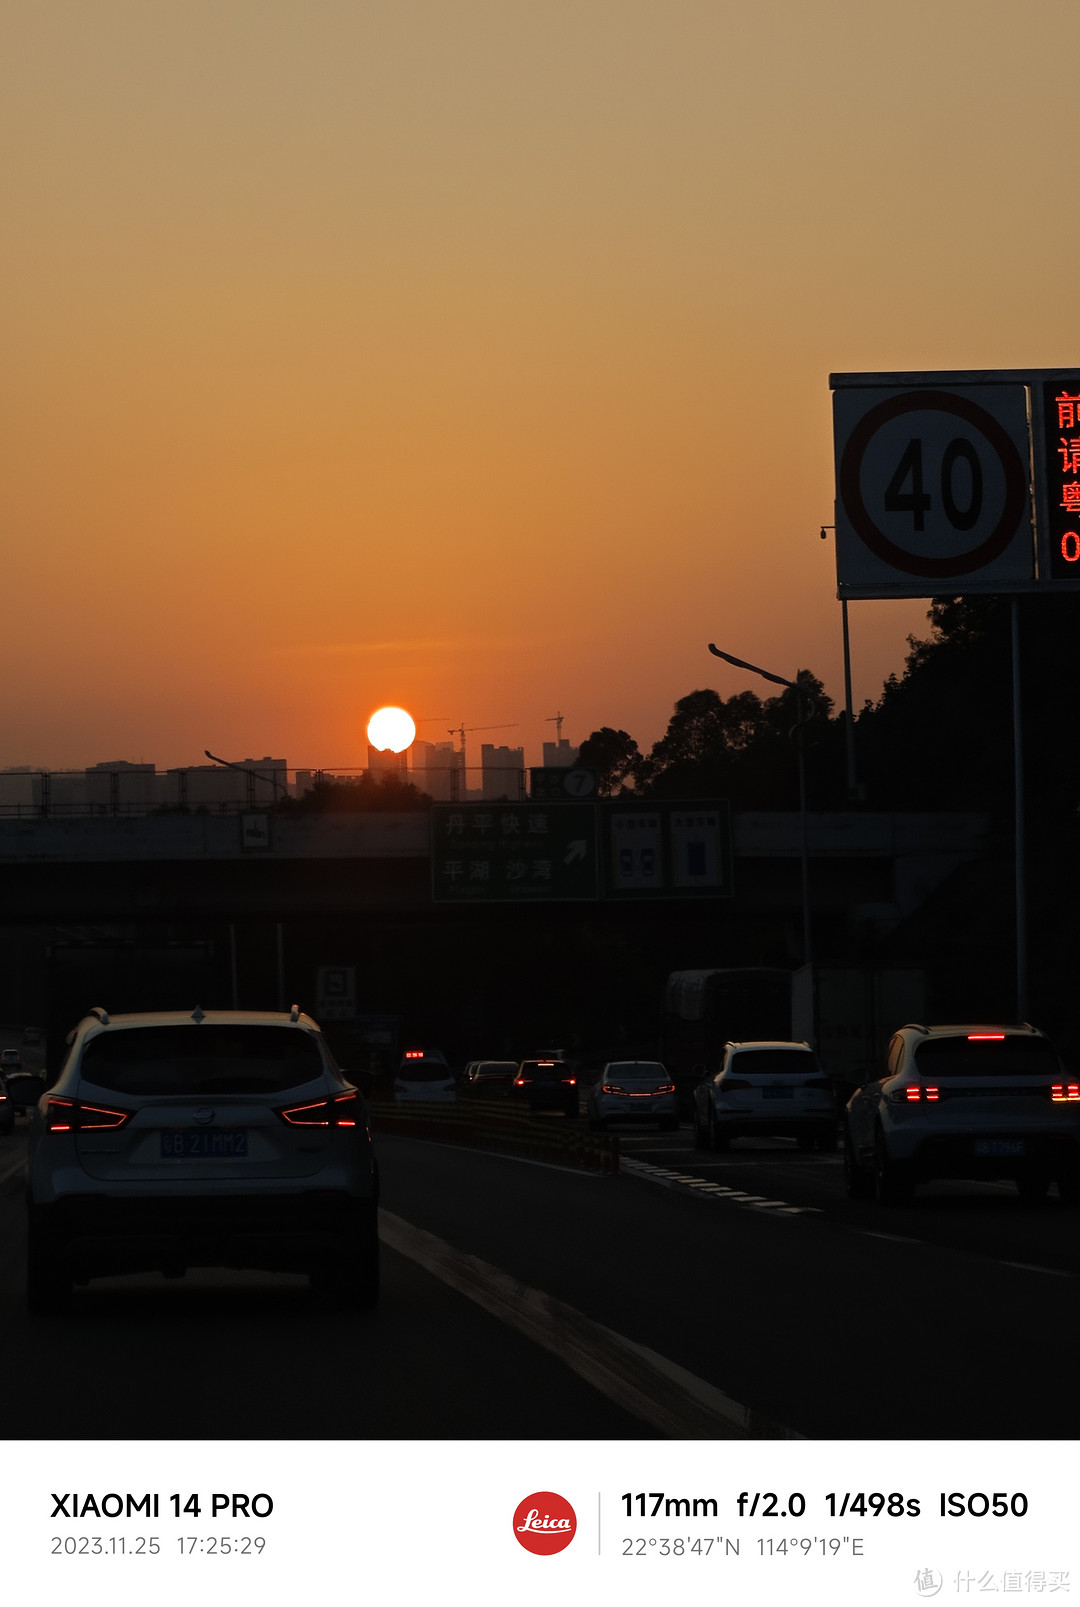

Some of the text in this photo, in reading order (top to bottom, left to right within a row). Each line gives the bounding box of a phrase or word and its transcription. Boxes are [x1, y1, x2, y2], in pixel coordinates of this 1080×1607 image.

[884, 437, 983, 531] 40
[575, 774, 587, 792] 7
[445, 812, 552, 835] 丹平快速
[442, 859, 489, 881] 平湖
